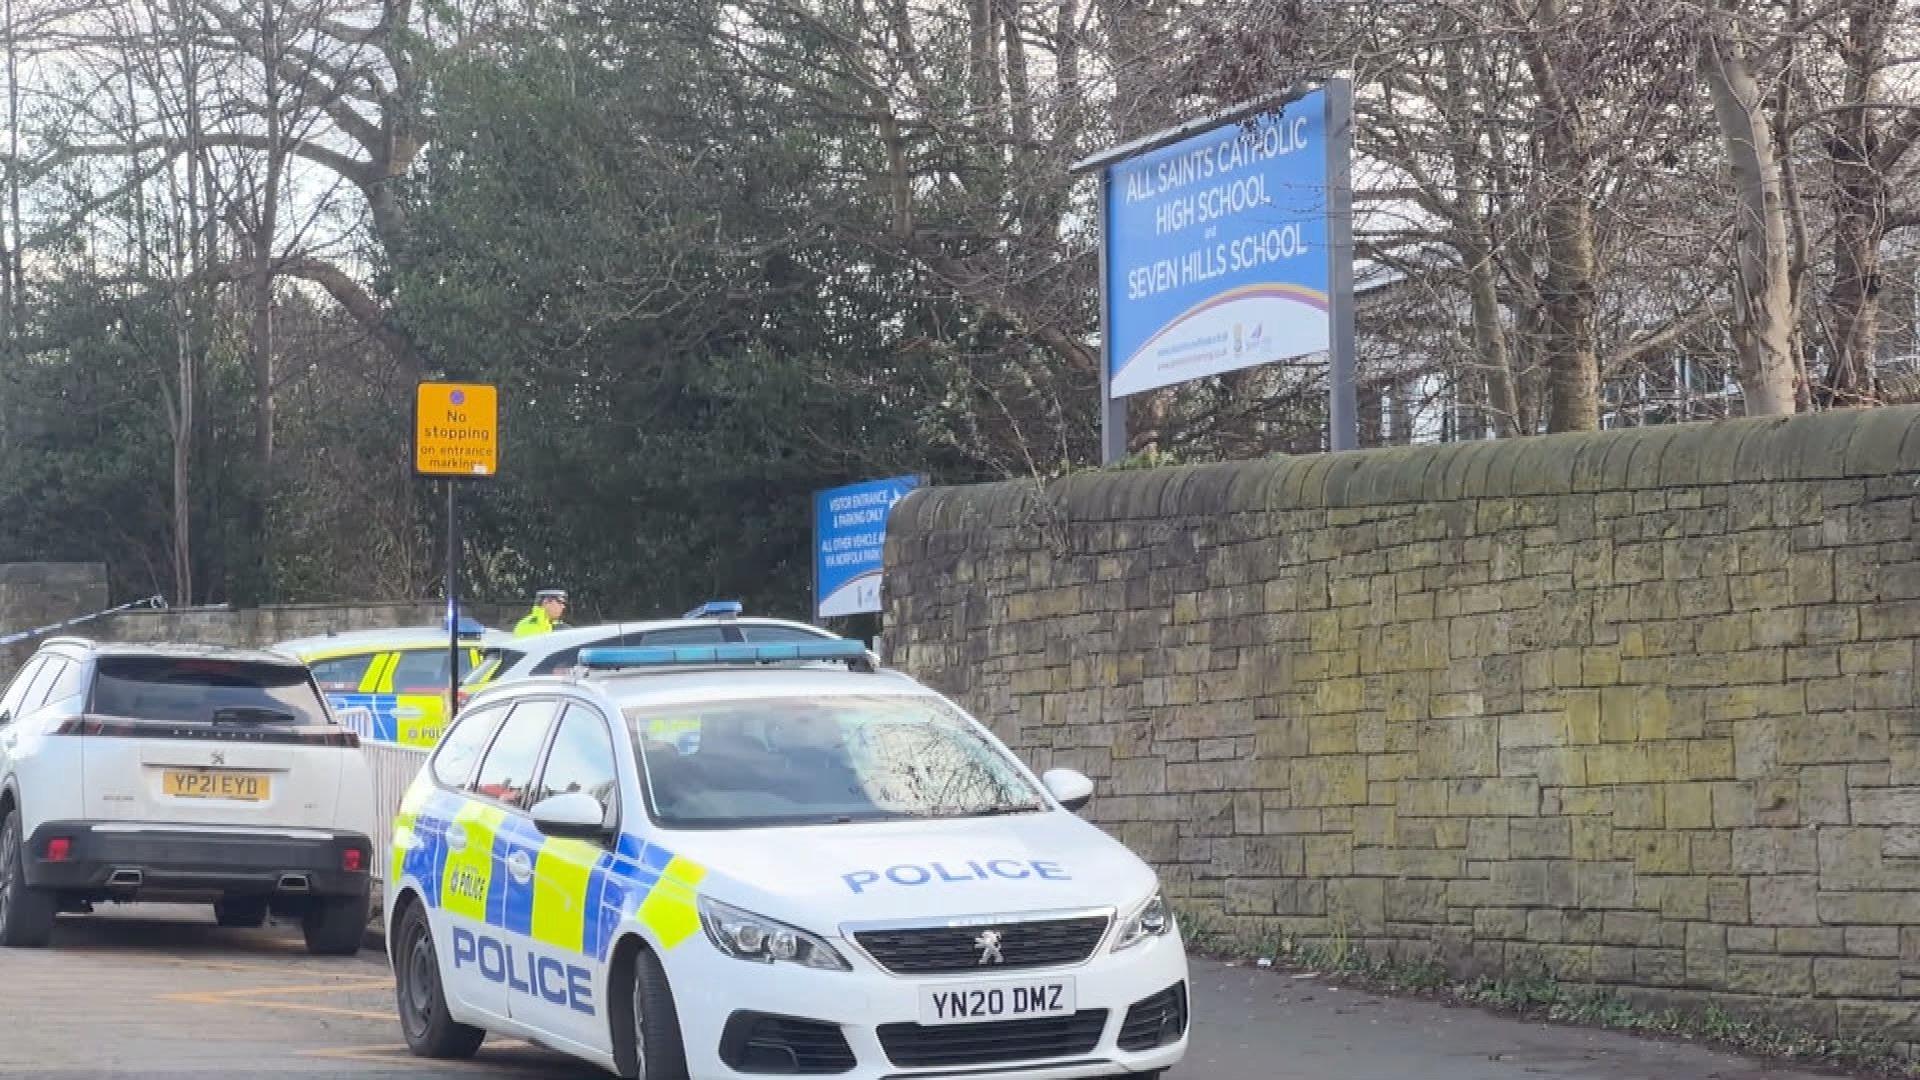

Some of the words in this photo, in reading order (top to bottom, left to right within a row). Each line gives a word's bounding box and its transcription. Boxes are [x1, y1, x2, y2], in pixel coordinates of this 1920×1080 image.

[1126, 170, 1155, 205] ALL
[1158, 147, 1214, 193] SAINTS
[1217, 117, 1308, 173] CATHOLIC
[1156, 197, 1194, 236] HIGH
[1199, 172, 1271, 223] SCHOOL
[1128, 257, 1178, 300] SEVEN
[1181, 243, 1226, 286] HILLS
[1230, 223, 1308, 271] SCHOOL
[447, 410, 467, 422] No
[424, 426, 489, 441] stopping
[421, 446, 435, 455] on
[440, 447, 493, 456] entrance
[829, 496, 853, 512] VISITOR
[853, 490, 888, 508] ENTRANCE
[839, 511, 864, 526] PARKING
[865, 508, 884, 522] ONLY
[175, 774, 216, 794] YP21
[221, 775, 258, 795] EYD
[458, 871, 486, 902] POLICE
[841, 858, 1073, 895] POLICE
[453, 925, 595, 1017] POLICE
[932, 988, 1001, 1020] YN20
[1013, 983, 1063, 1014] DMZ
